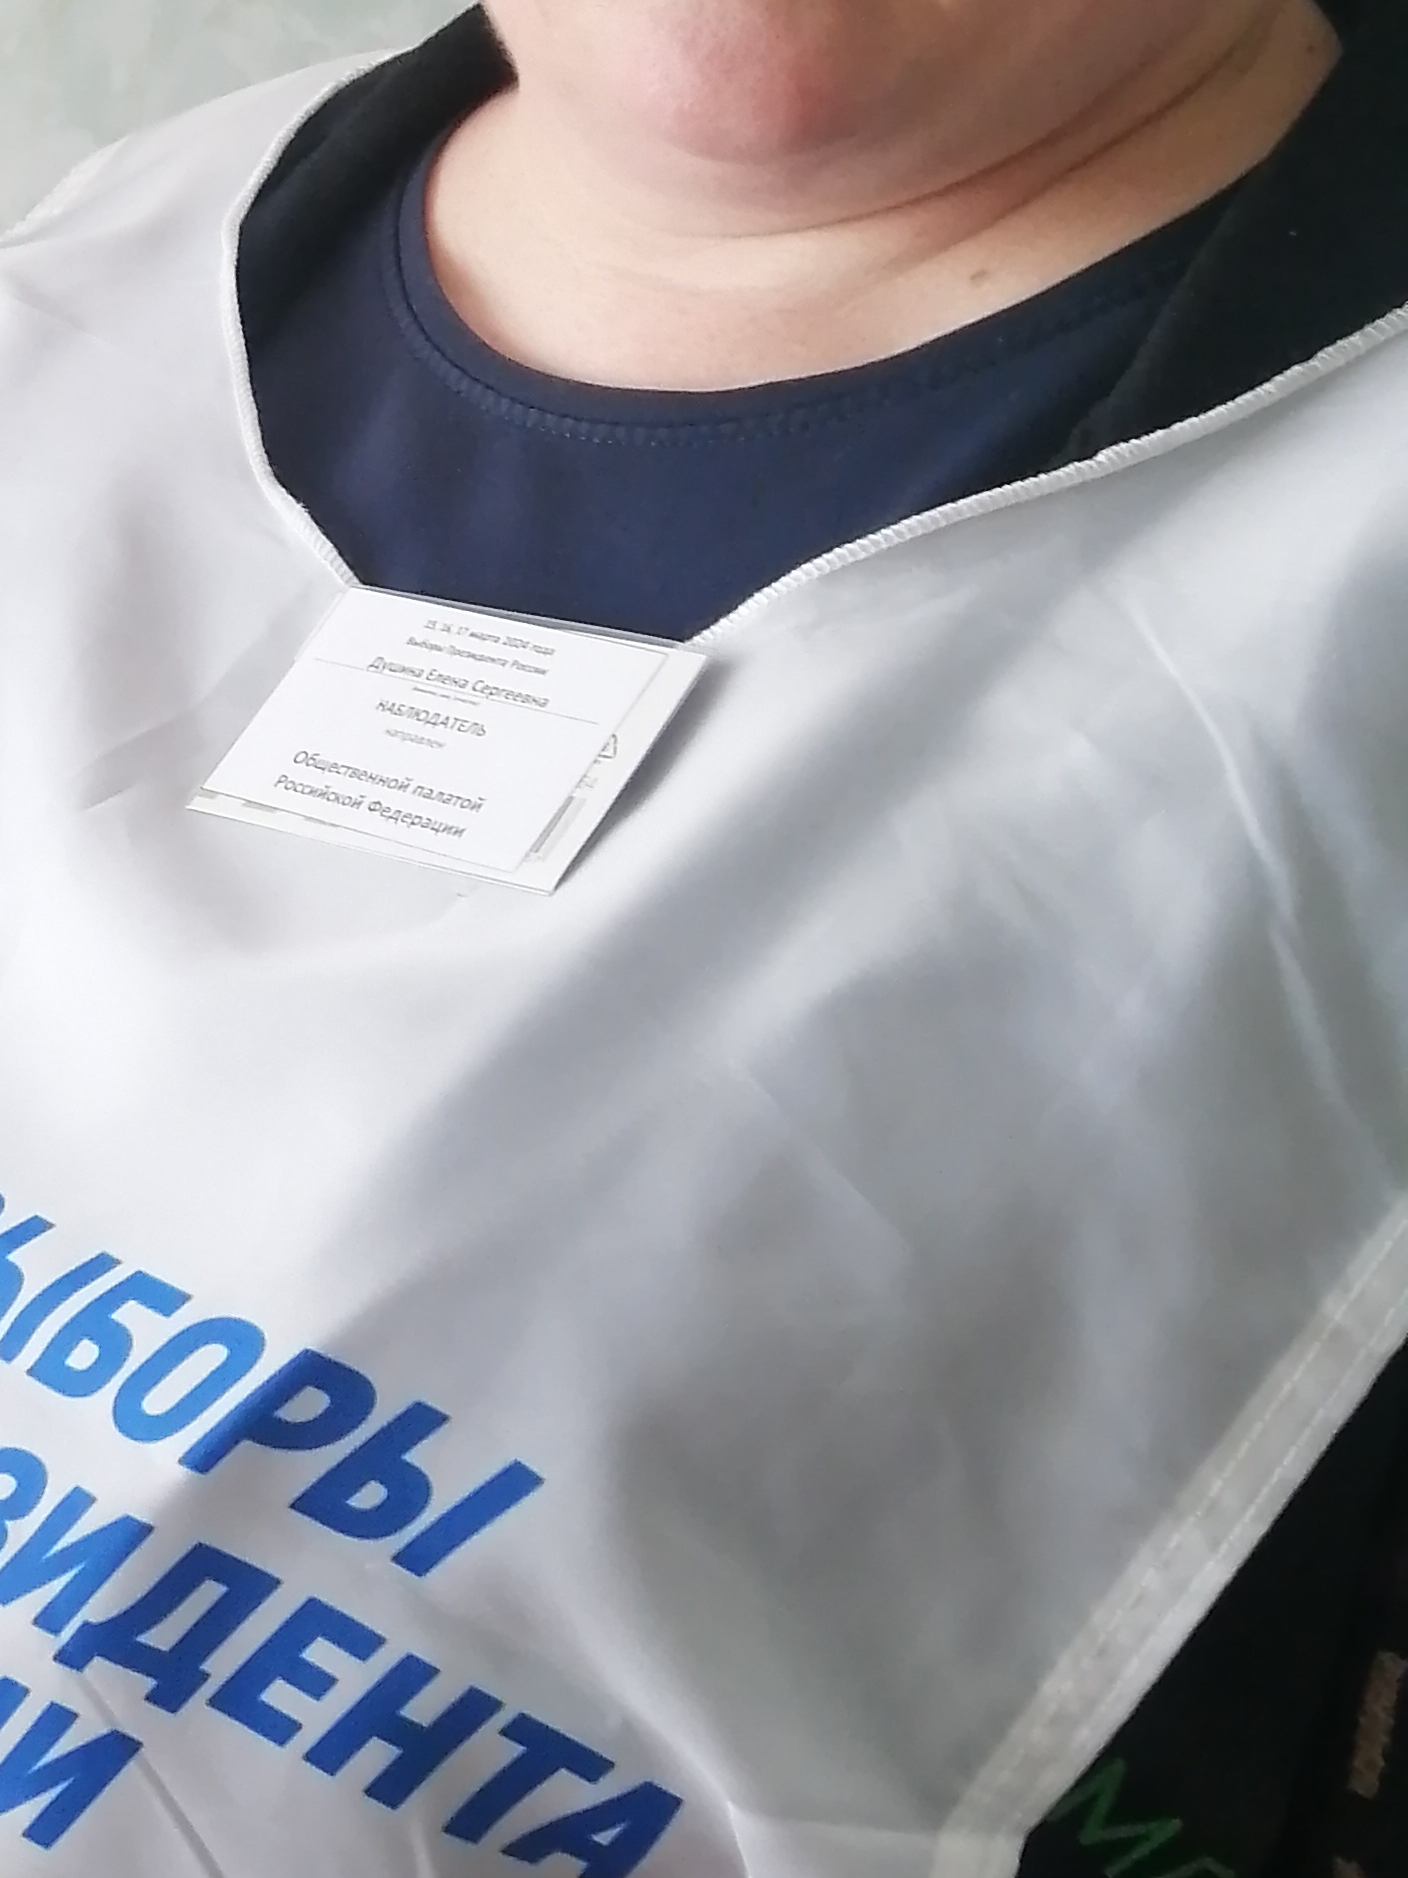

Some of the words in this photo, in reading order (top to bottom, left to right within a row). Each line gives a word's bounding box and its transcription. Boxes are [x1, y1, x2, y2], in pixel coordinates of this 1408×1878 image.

[425, 668, 470, 690] Елена
[471, 679, 550, 708] Сергеевна
[375, 699, 487, 737] НАБЛЮДАТЕЛЬ
[273, 774, 364, 810] Российской
[366, 797, 466, 839] Федерации
[292, 750, 411, 794] Общественной
[412, 783, 486, 813] палатой
